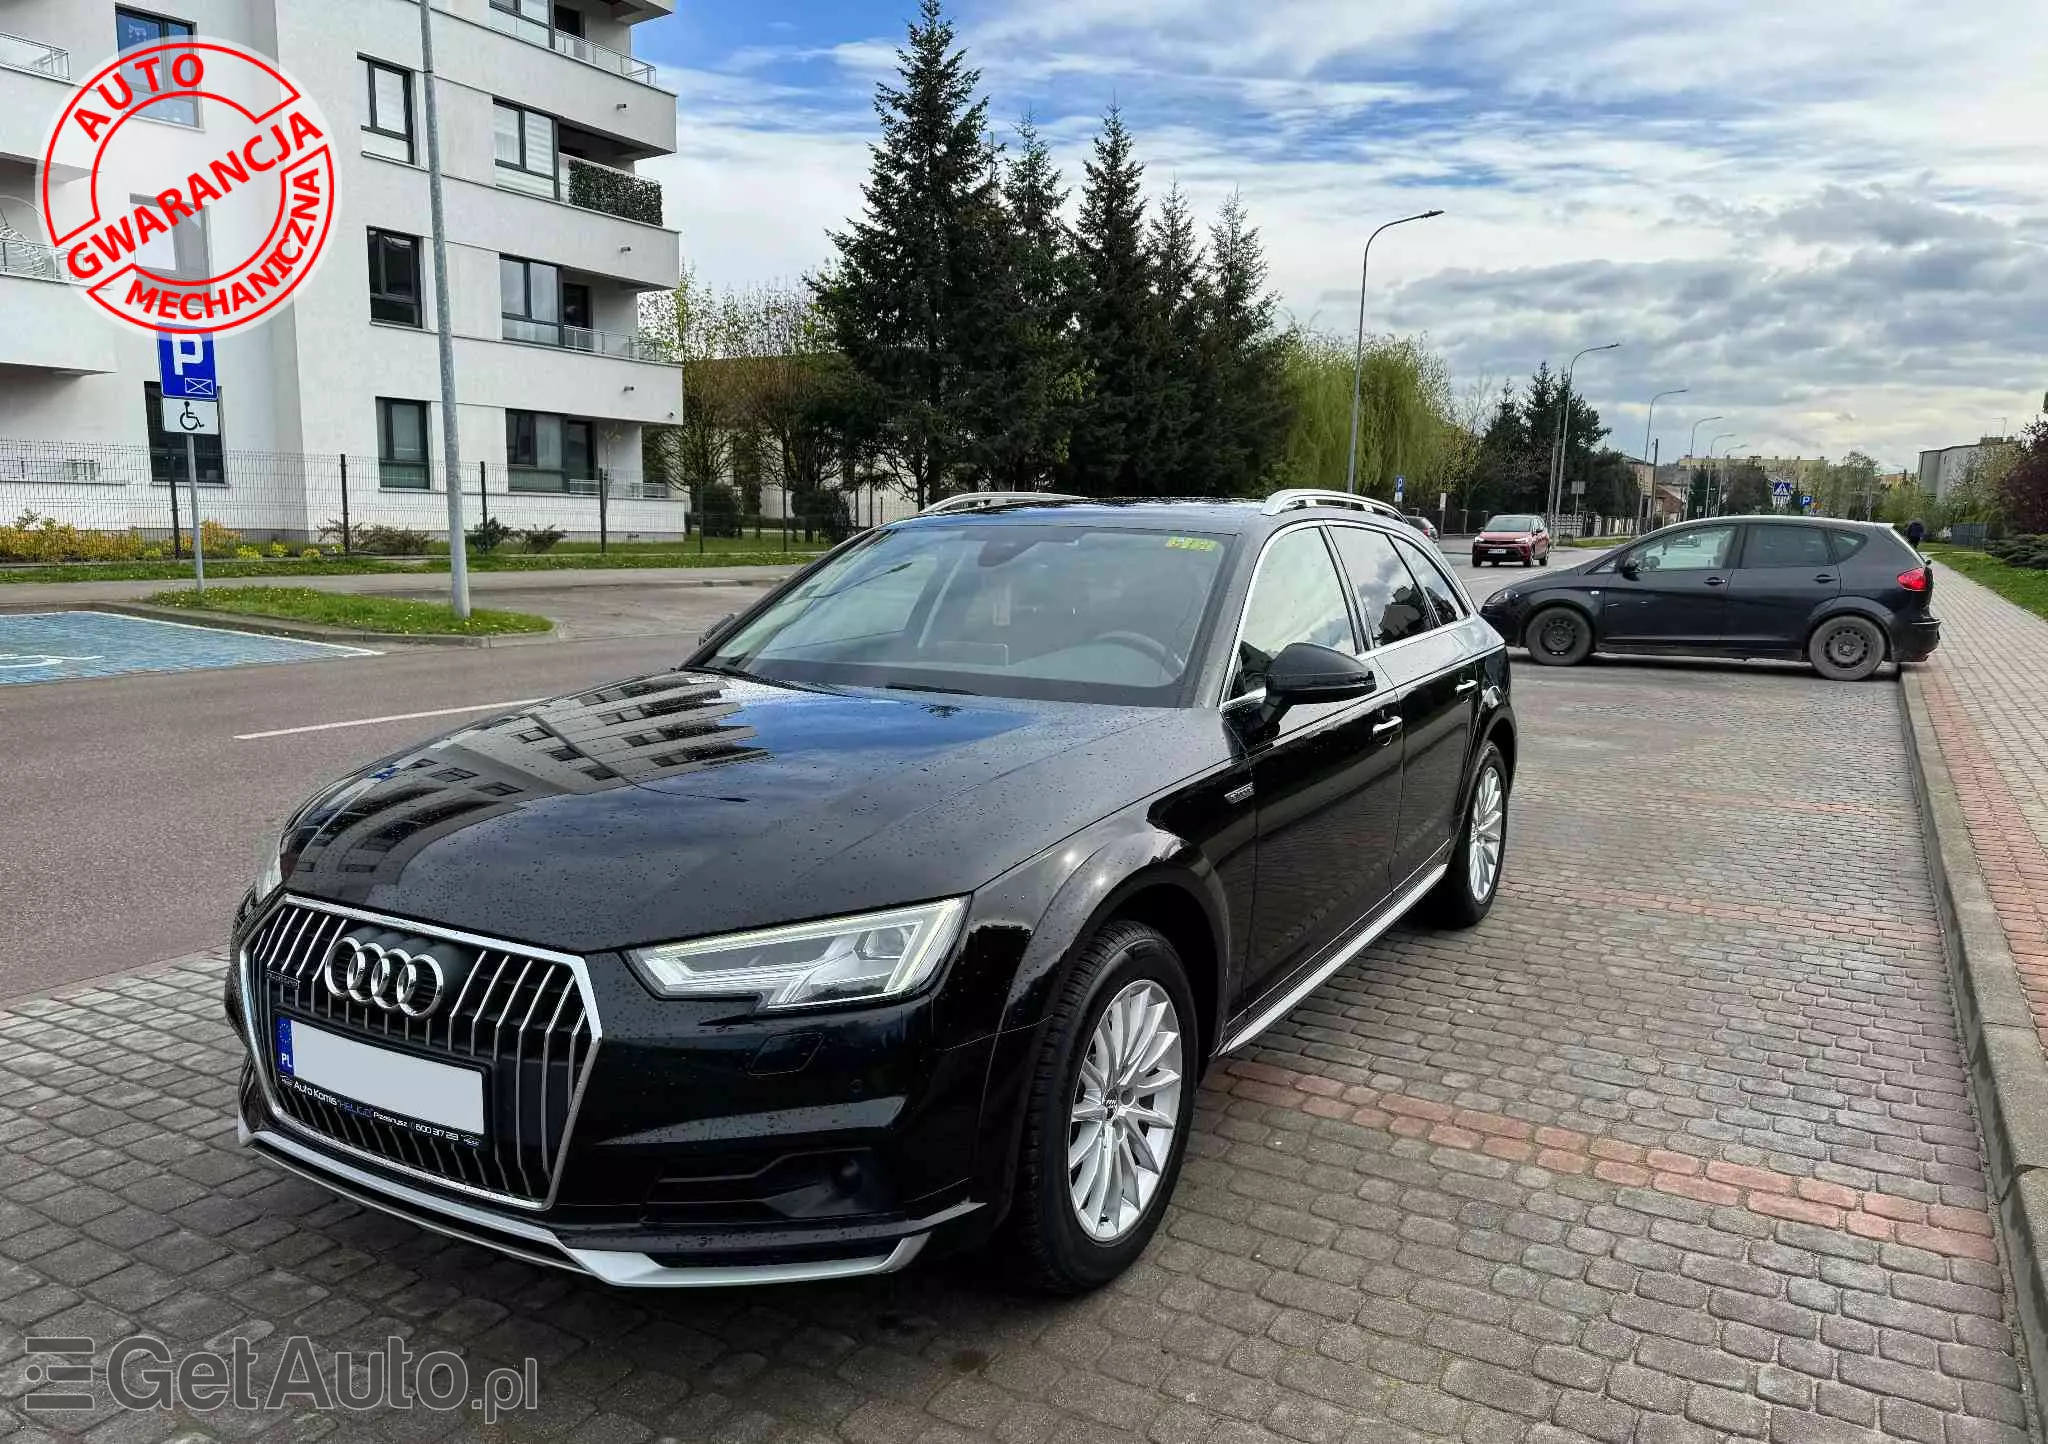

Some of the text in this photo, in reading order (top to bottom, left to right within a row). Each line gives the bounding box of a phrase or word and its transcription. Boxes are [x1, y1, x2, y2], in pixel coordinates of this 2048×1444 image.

[171, 332, 204, 376] P
[1802, 496, 1810, 504] P
[281, 1052, 293, 1068] PL
[294, 1080, 313, 1096] Auto
